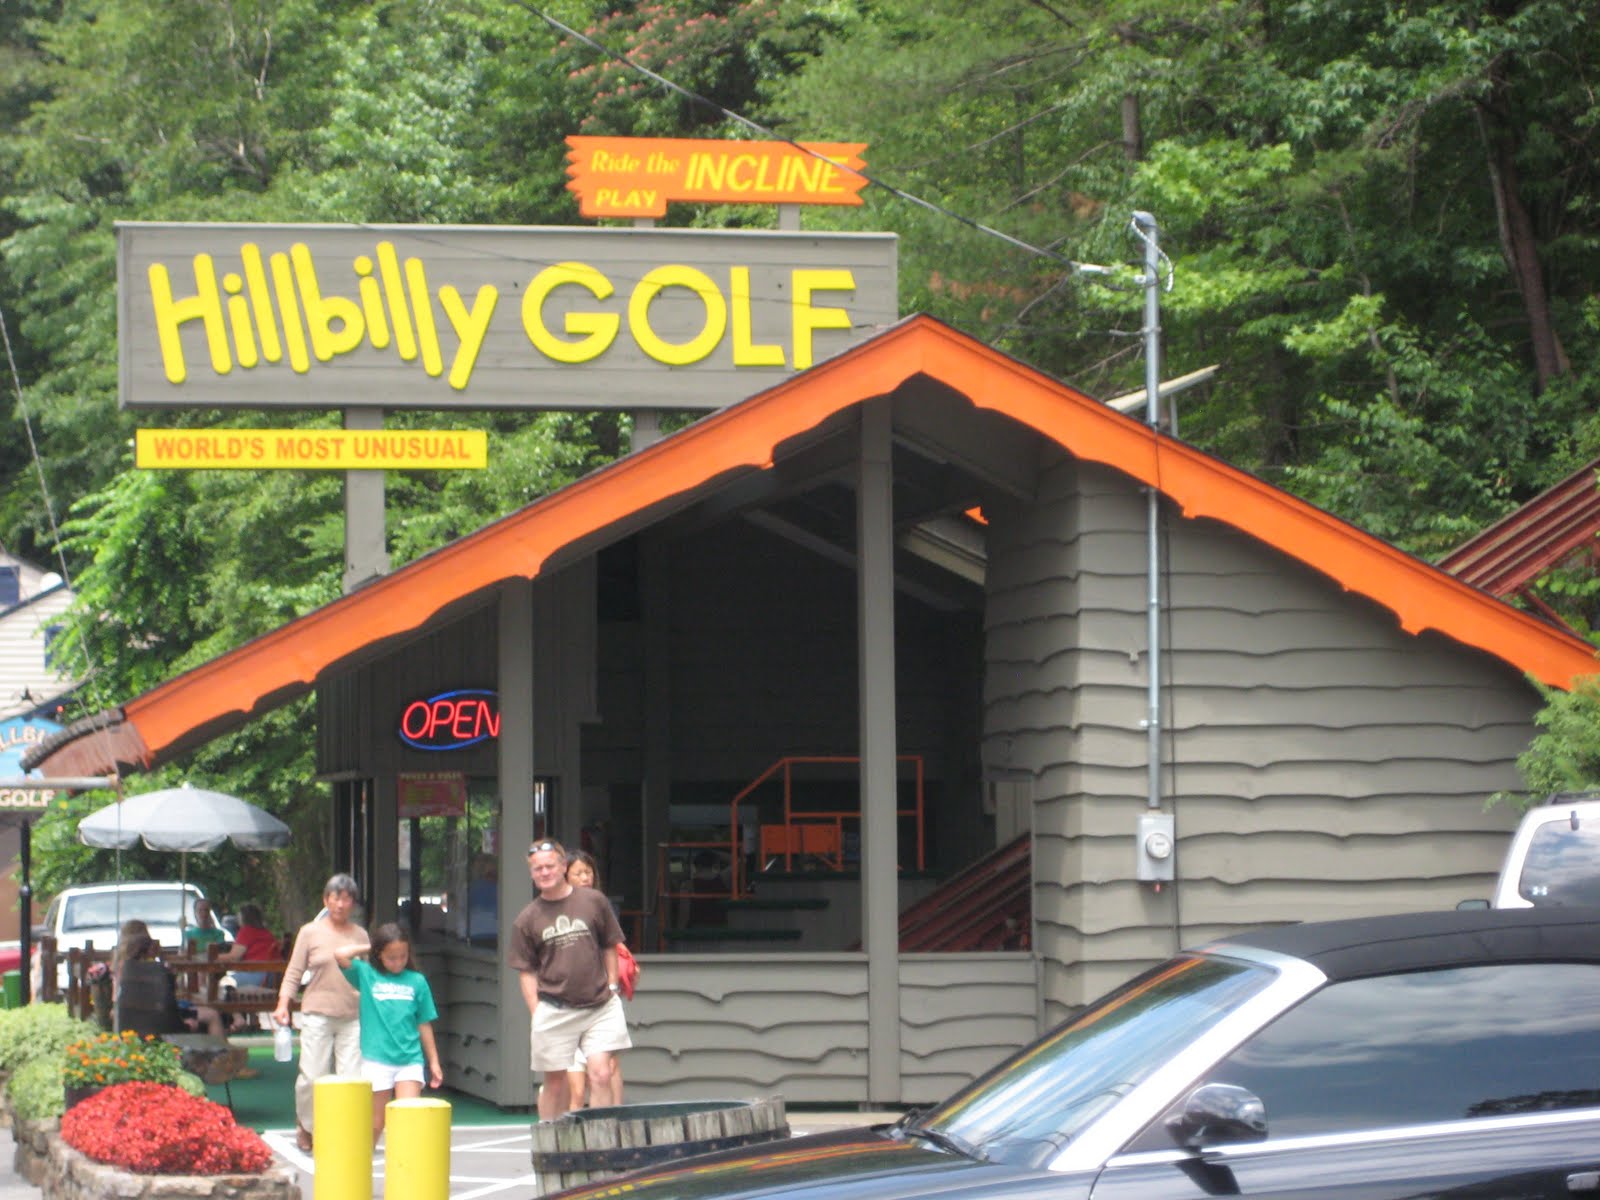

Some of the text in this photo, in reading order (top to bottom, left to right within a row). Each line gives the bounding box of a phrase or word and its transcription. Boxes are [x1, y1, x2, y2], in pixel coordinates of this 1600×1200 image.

[591, 150, 849, 193] Ride the INCLINE
[595, 188, 657, 209] PLAY
[148, 240, 856, 390] Hillbilly GOLF
[153, 436, 471, 460] WORLD'S MOST UNUSUAL
[402, 700, 501, 739] OPEN
[0, 789, 55, 808] GOLF
